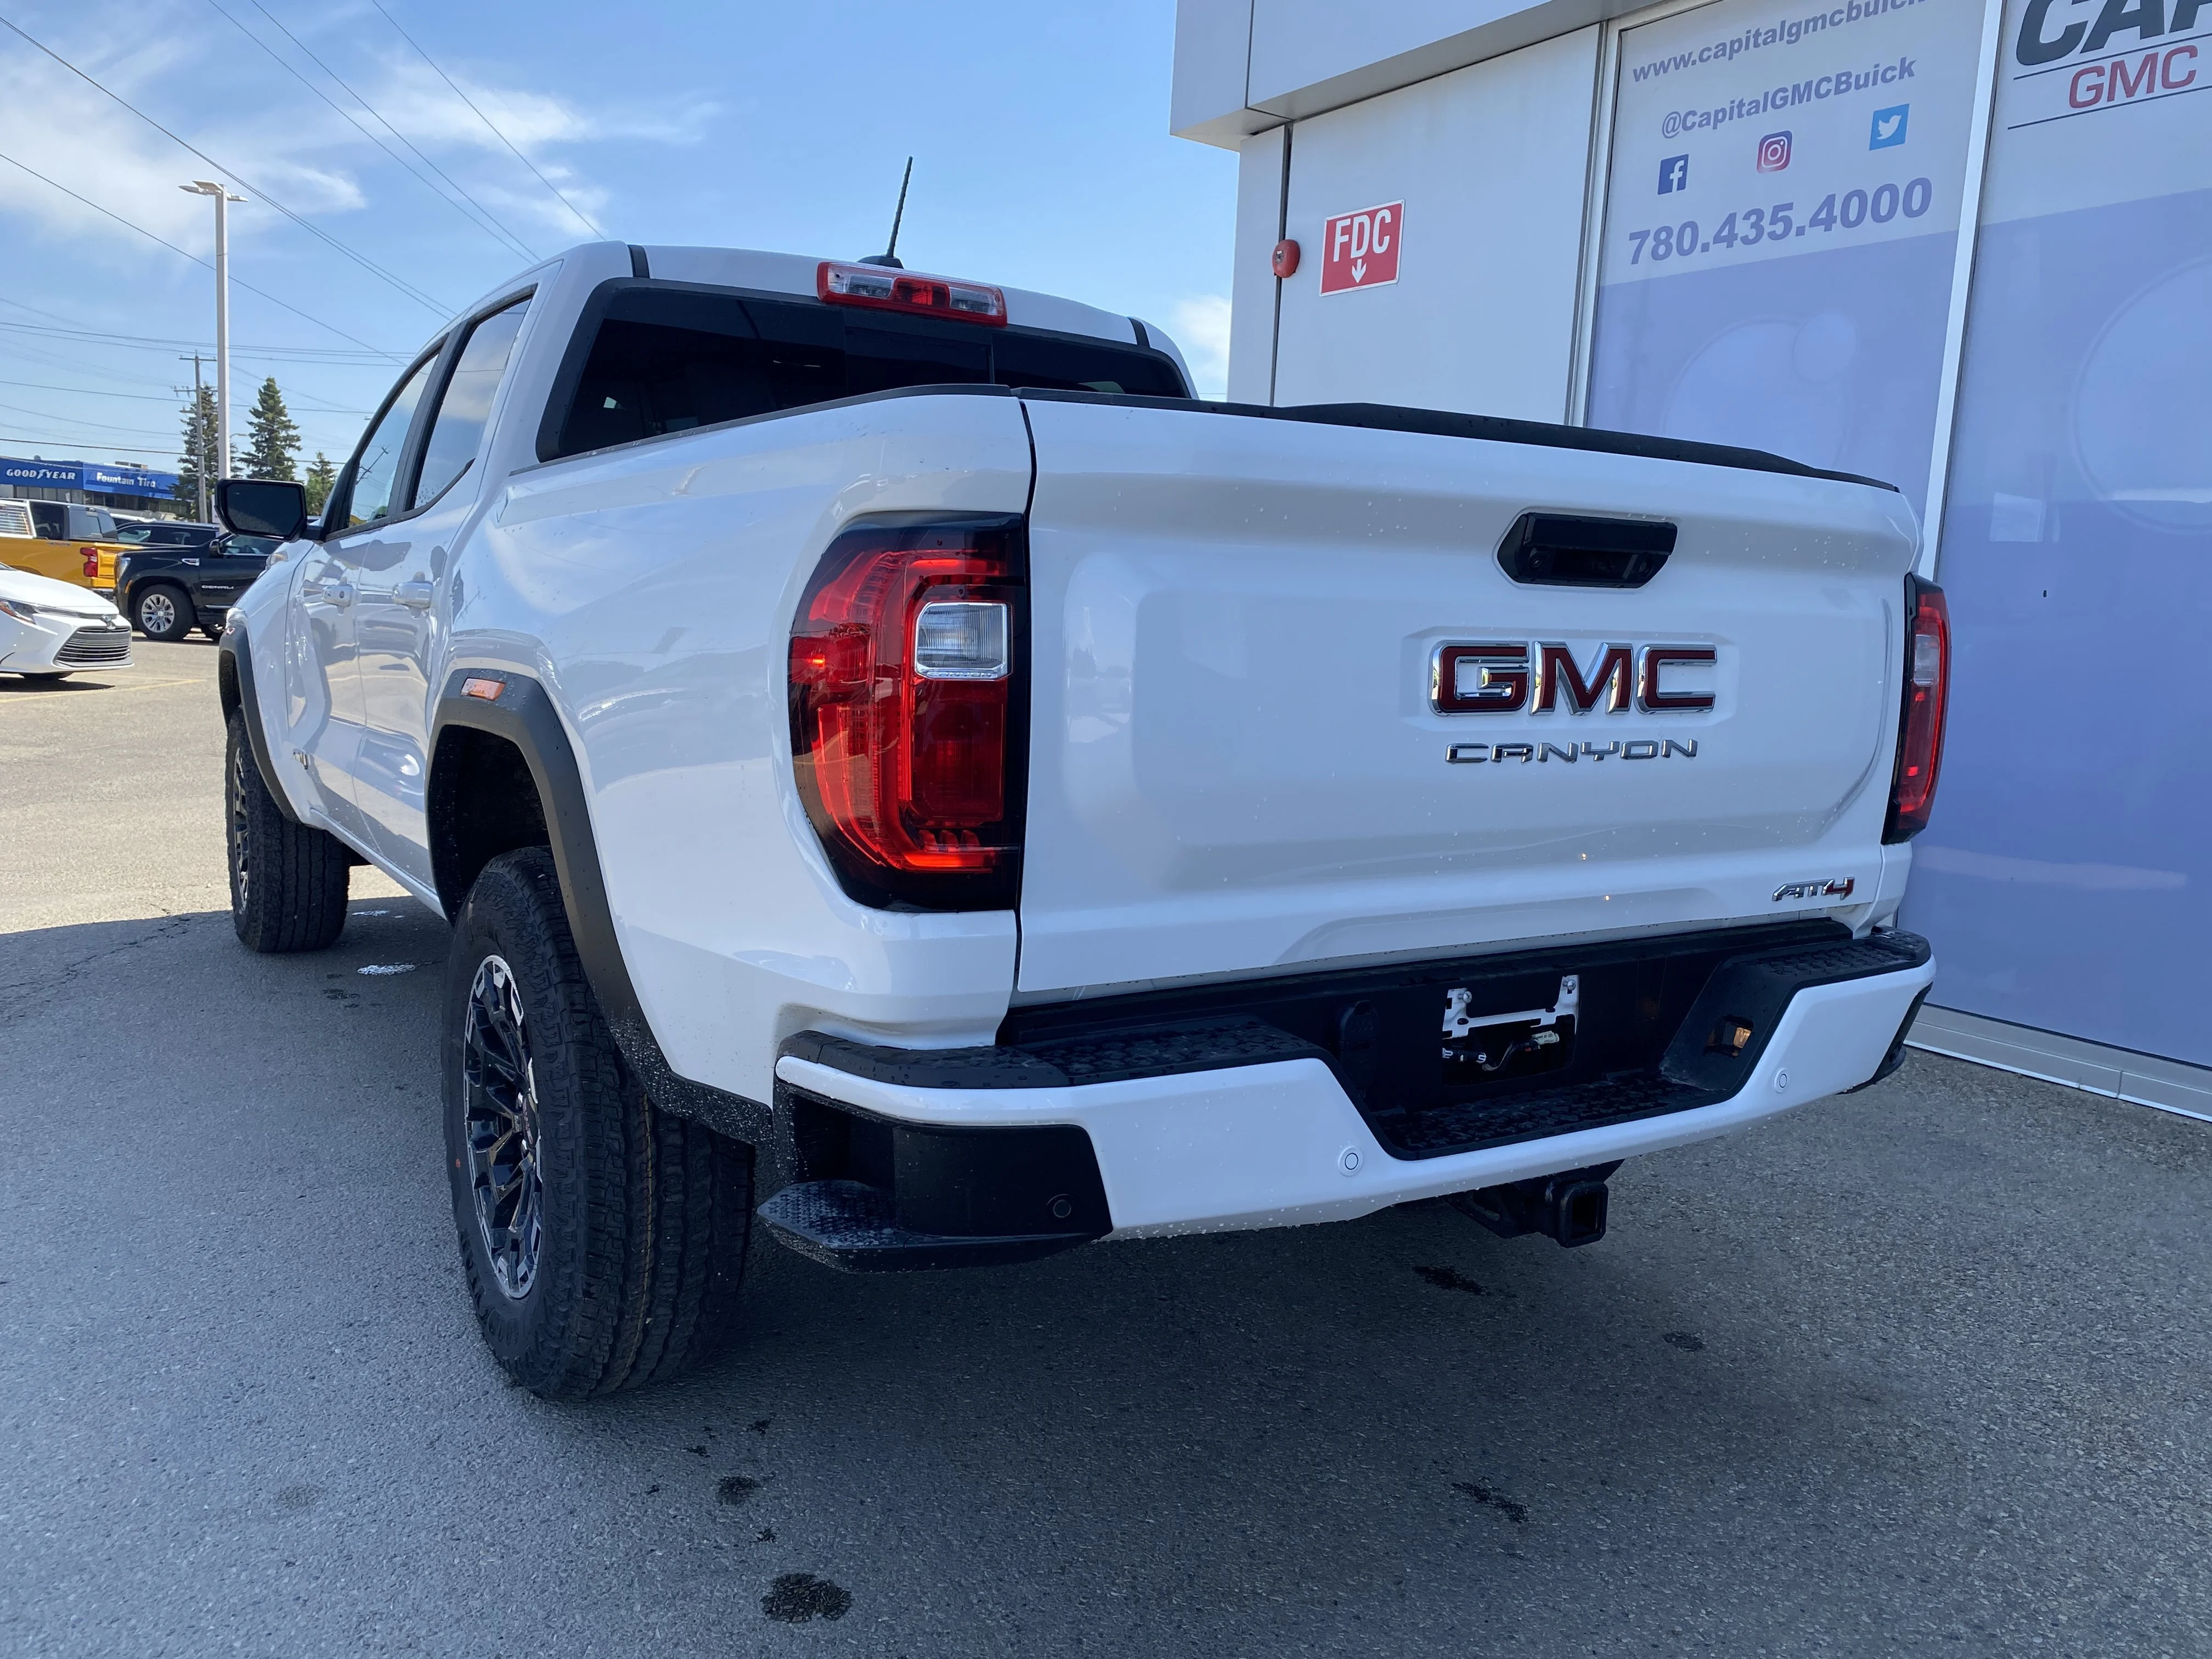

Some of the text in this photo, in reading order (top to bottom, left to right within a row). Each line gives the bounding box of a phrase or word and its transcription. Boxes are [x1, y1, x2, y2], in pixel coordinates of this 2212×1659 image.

[1633, 0, 1926, 82] www.capitalgmcbuic
[1662, 57, 1916, 139] @CapitalGMCBuick
[2069, 45, 2198, 108] GMC
[1333, 209, 1391, 262] FDC
[1629, 177, 1932, 265] 780.435.4000
[97, 472, 156, 488] Fountain Tire
[1428, 640, 1717, 715] GMC
[1445, 739, 1698, 764] CANYON
[1772, 877, 1855, 901] AT4
